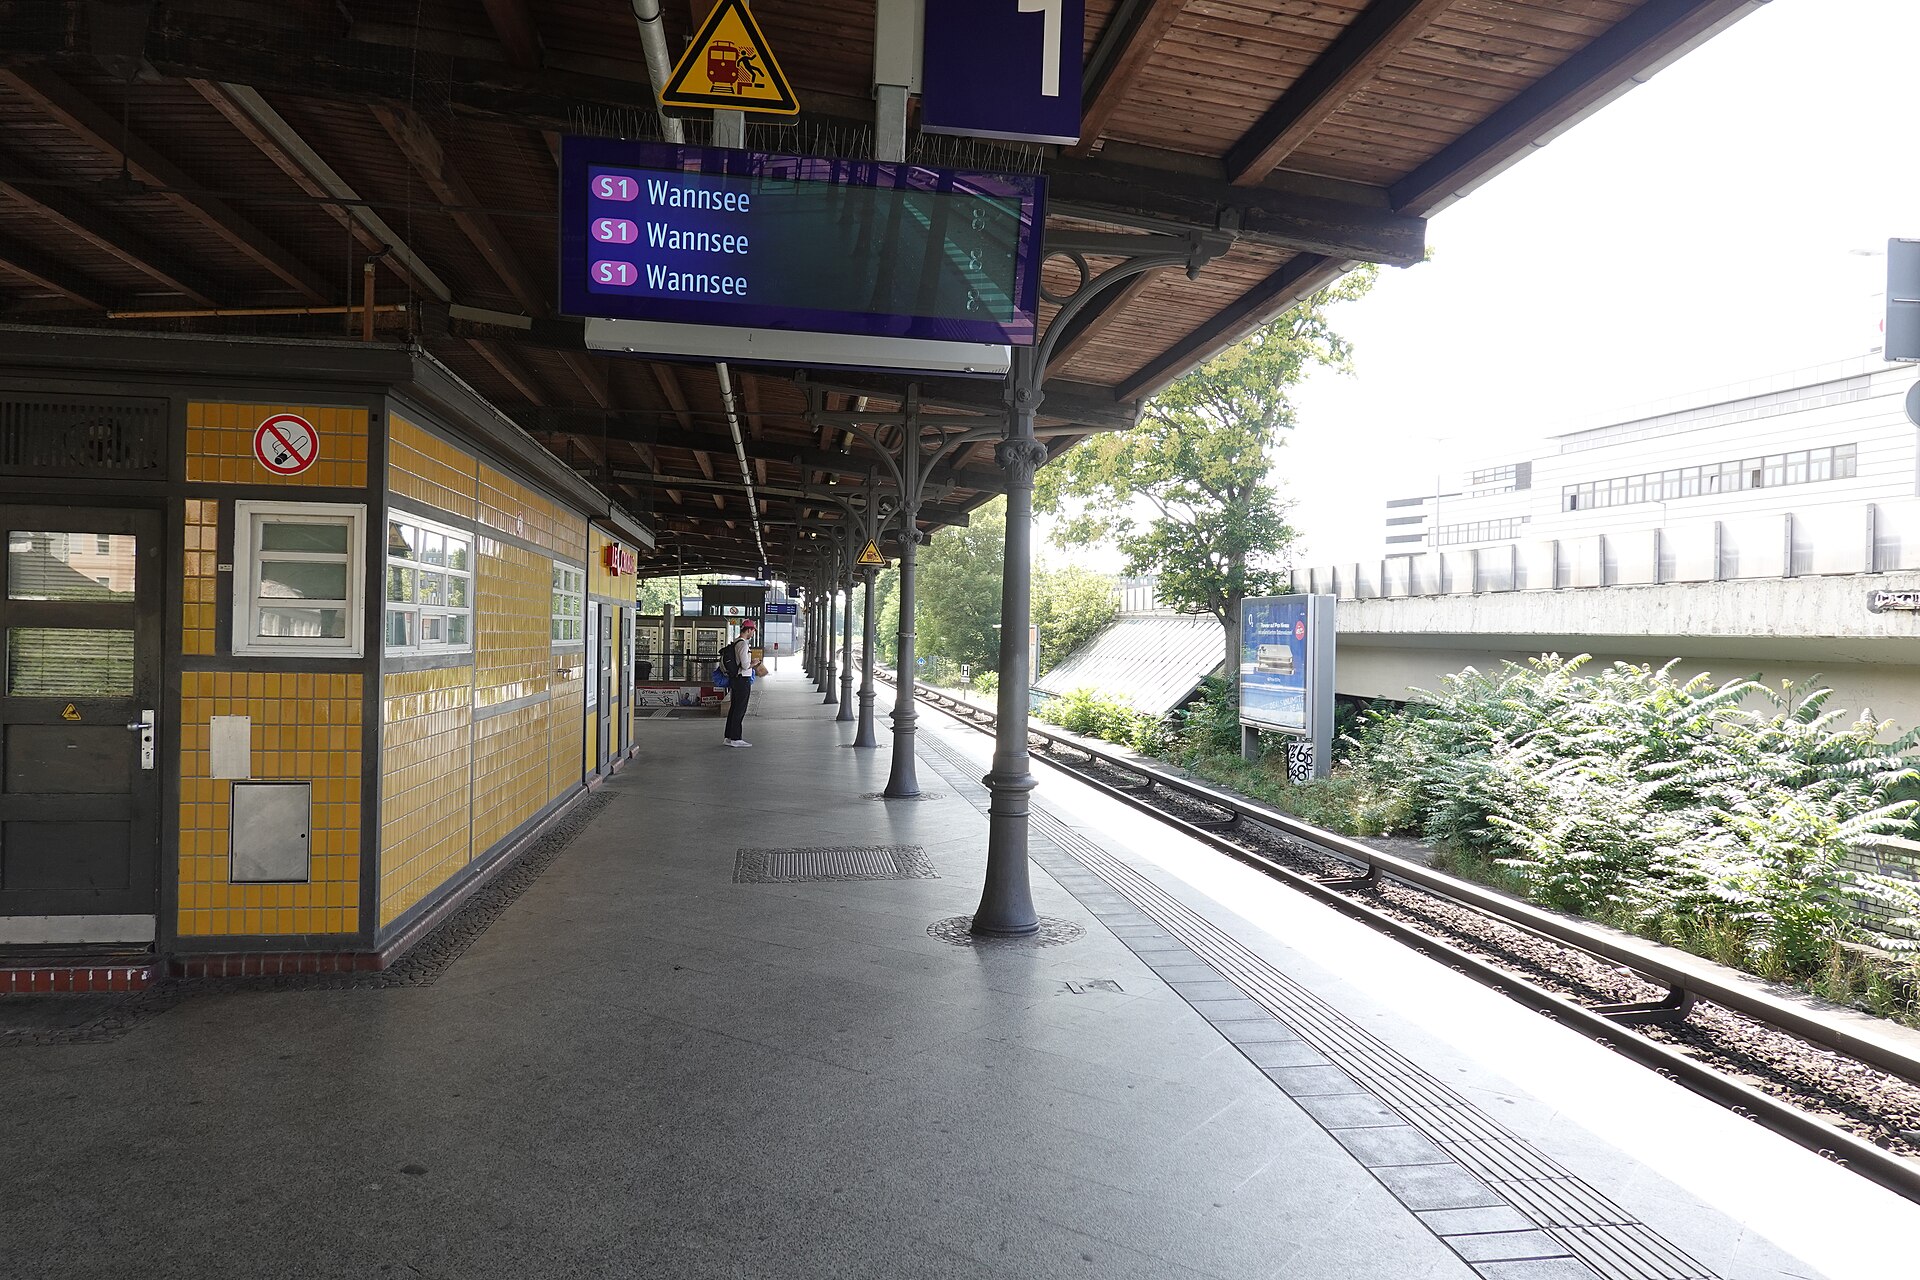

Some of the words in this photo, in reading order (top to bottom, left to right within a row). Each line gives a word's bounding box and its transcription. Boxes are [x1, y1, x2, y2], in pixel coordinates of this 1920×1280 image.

[1018, 0, 1062, 97] 1
[647, 179, 750, 212] Wannsee
[646, 221, 749, 254] Wannsee
[646, 263, 748, 296] Wannsee
[962, 665, 969, 675] H
